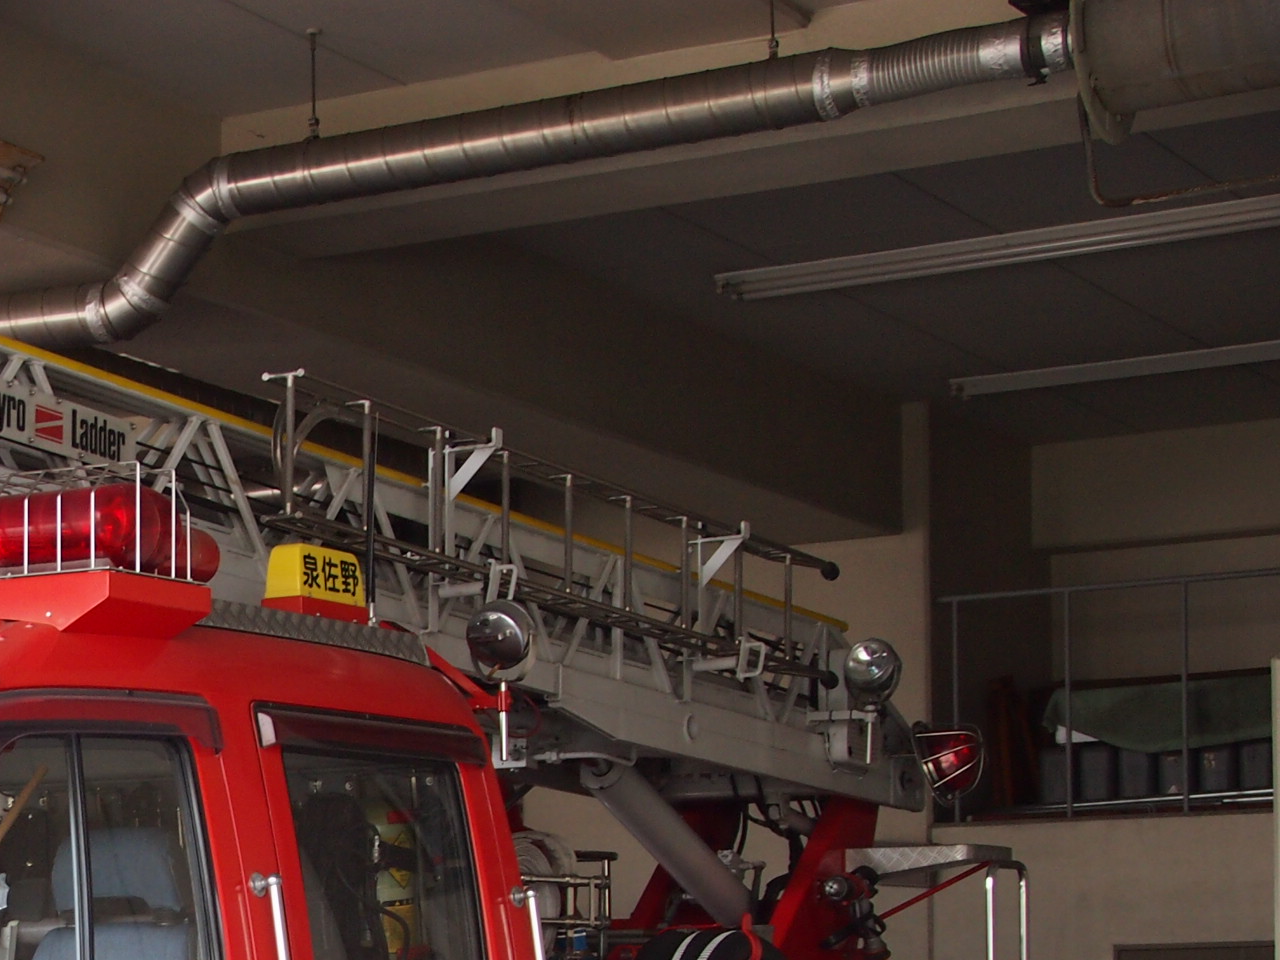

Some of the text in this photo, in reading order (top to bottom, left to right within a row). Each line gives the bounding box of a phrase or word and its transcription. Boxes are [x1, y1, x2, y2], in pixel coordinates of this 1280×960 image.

[71, 408, 126, 462] Ladder
[302, 553, 360, 597] 泉佐野
